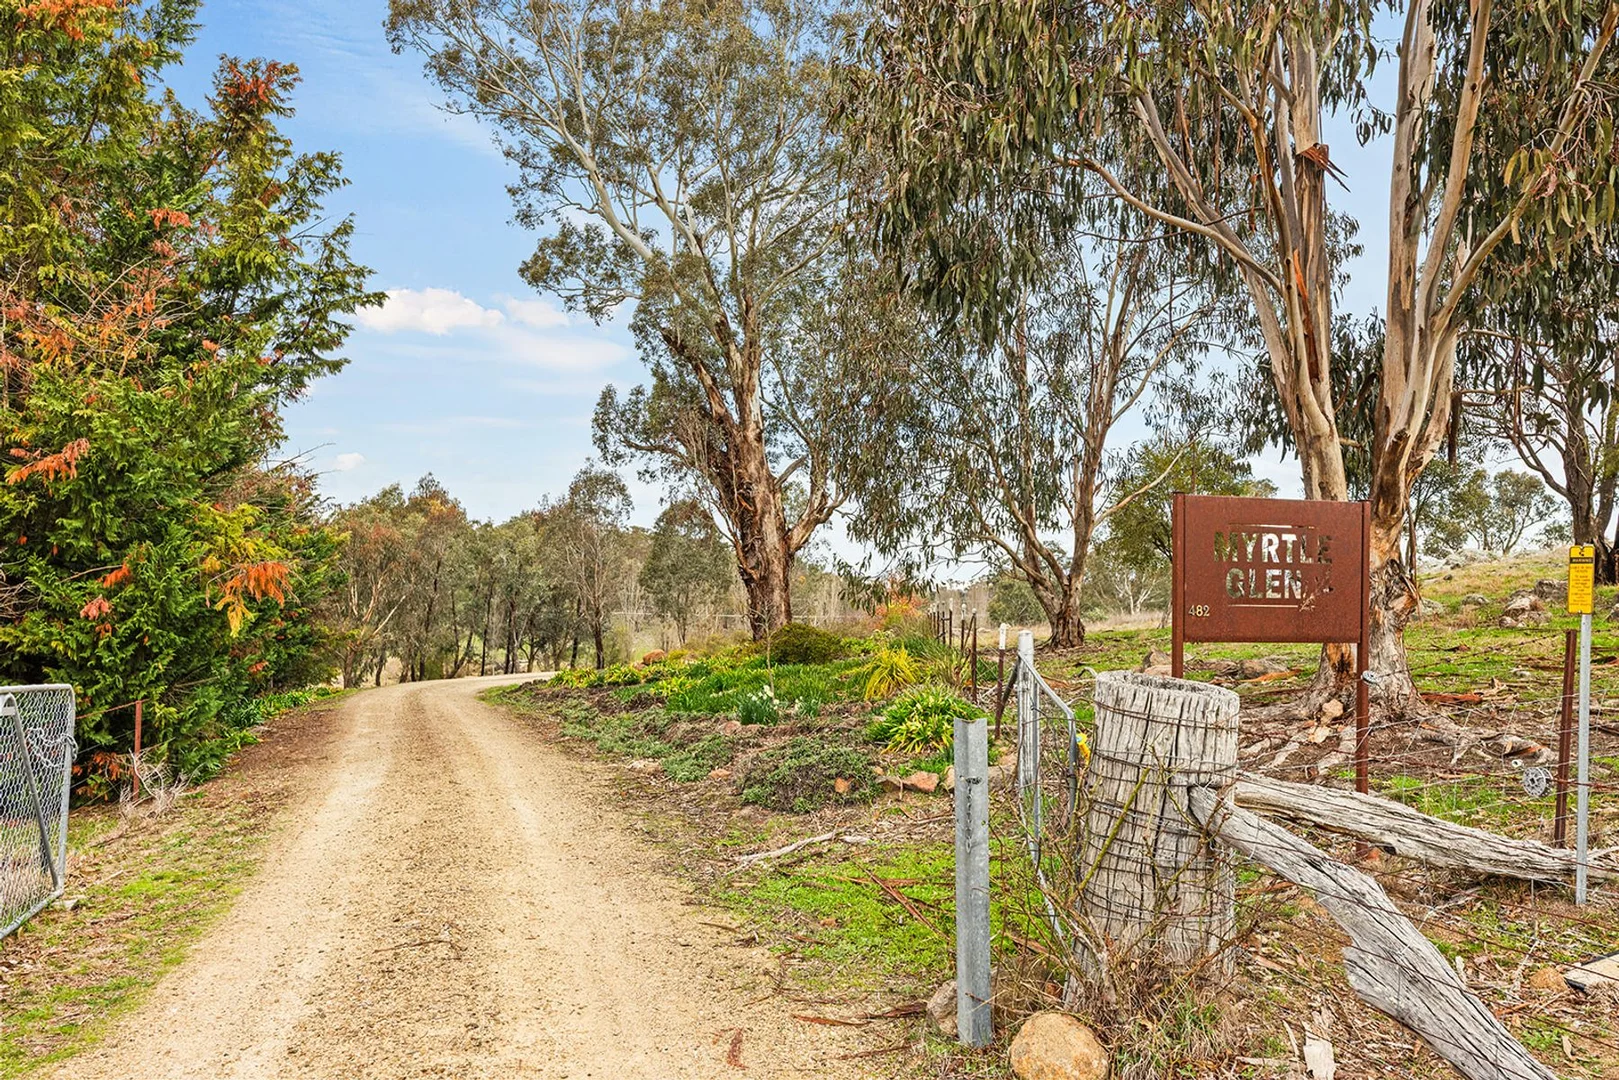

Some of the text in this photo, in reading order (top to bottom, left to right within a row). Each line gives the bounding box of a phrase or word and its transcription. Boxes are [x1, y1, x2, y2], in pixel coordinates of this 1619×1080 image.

[1214, 532, 1332, 564] MYRTLE
[1226, 568, 1302, 599] GLEN
[1188, 605, 1210, 617] 482
